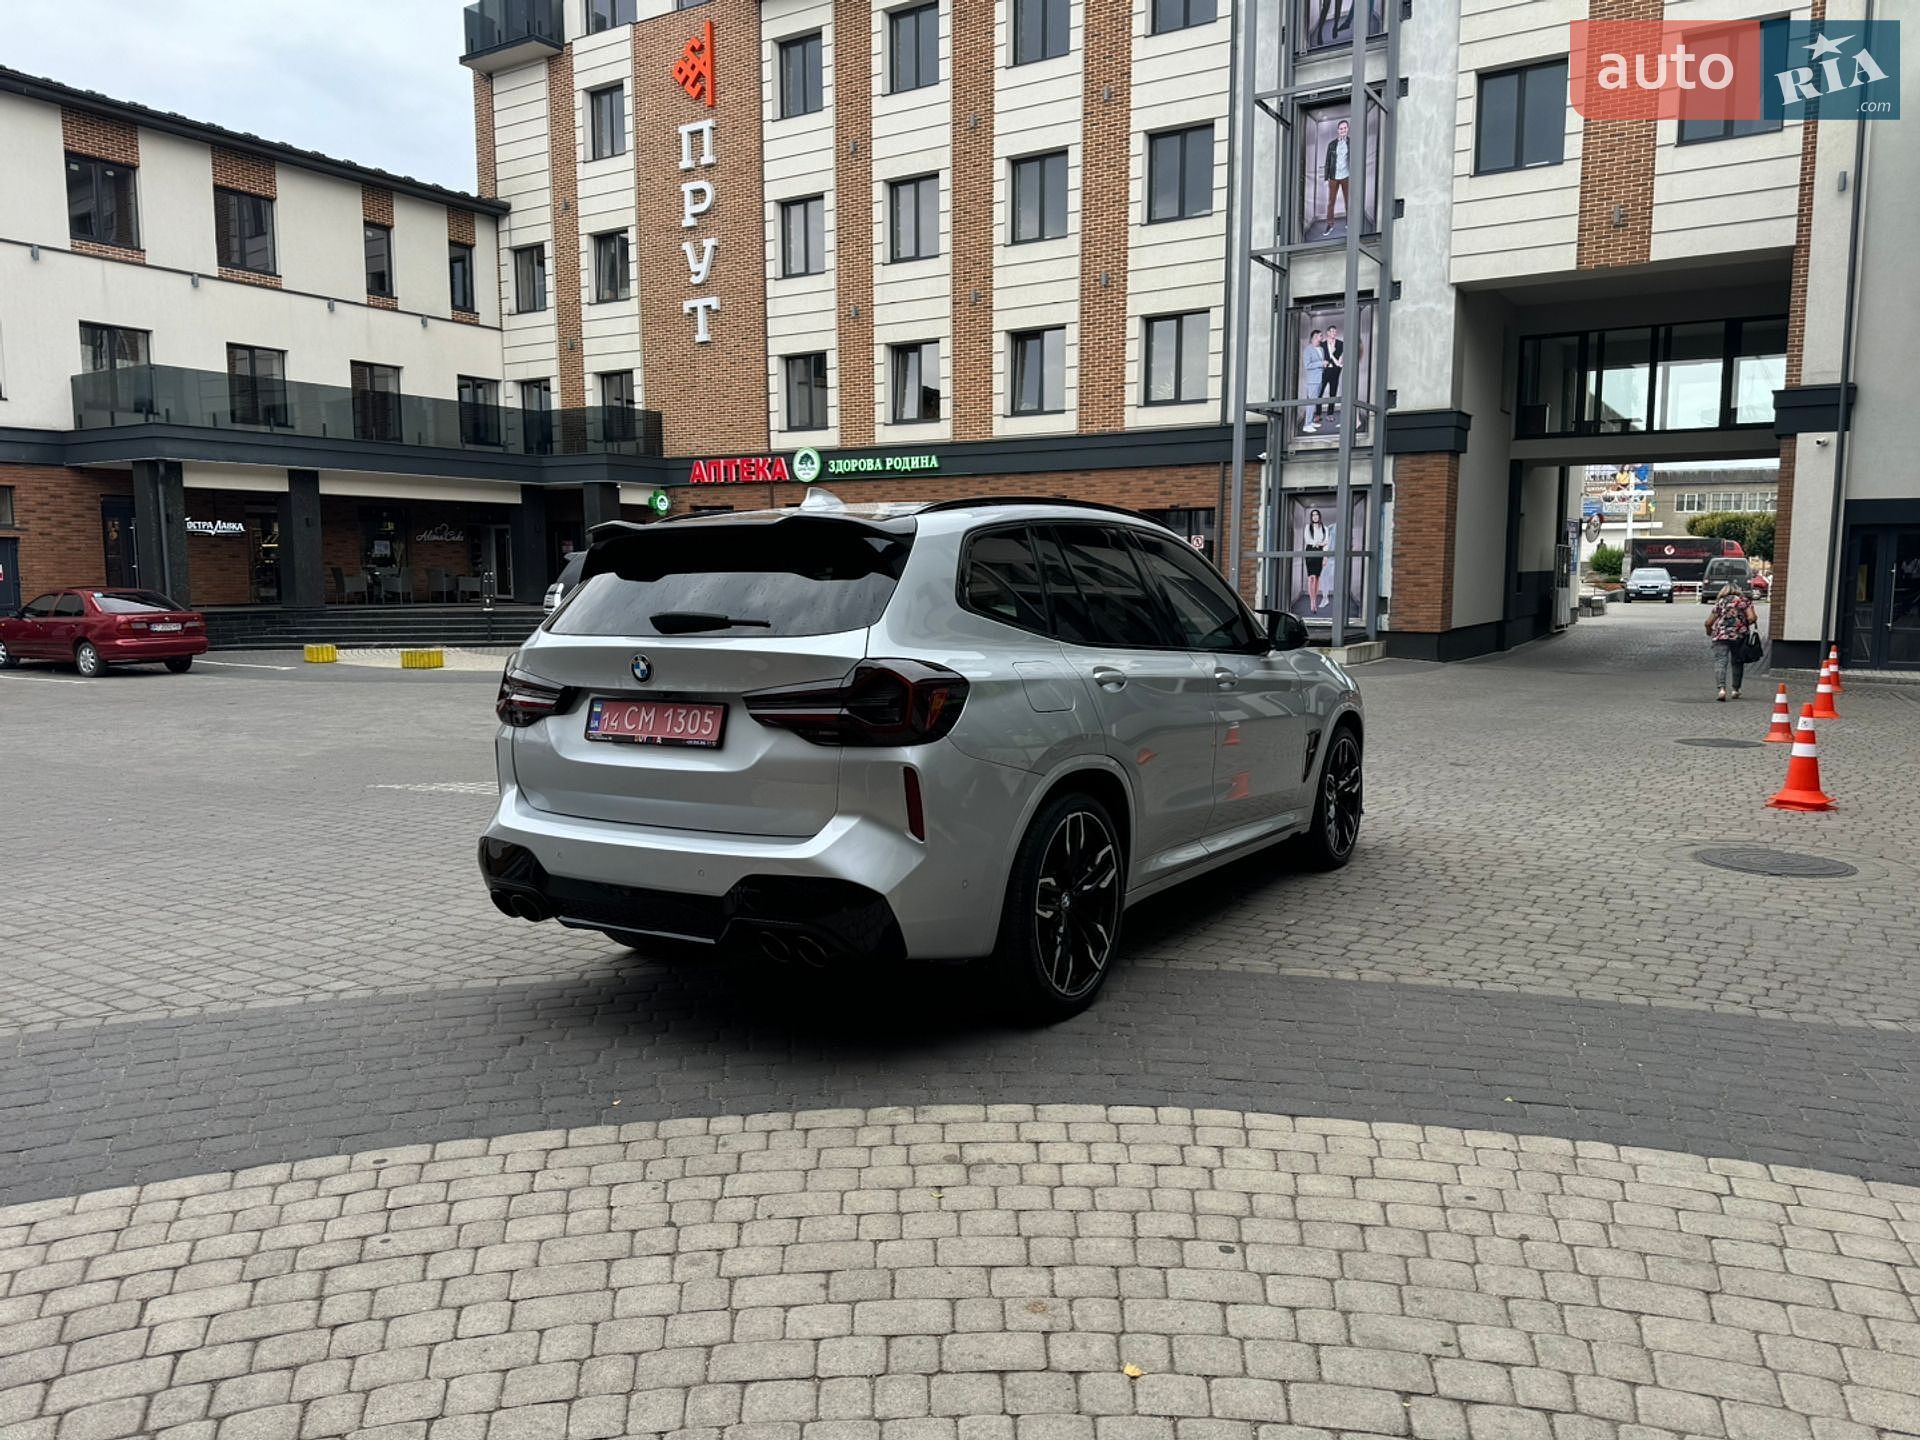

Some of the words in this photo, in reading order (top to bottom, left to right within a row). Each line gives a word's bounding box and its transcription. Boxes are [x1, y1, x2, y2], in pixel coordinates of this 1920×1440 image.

[678, 118, 721, 343] ПРУТ
[690, 457, 790, 483] АПТЕКА
[828, 458, 882, 474] ЗДОРОВА
[885, 455, 939, 471] РОДИНА
[603, 711, 622, 730] 14
[624, 706, 656, 731] CM
[664, 708, 714, 735] 1305
